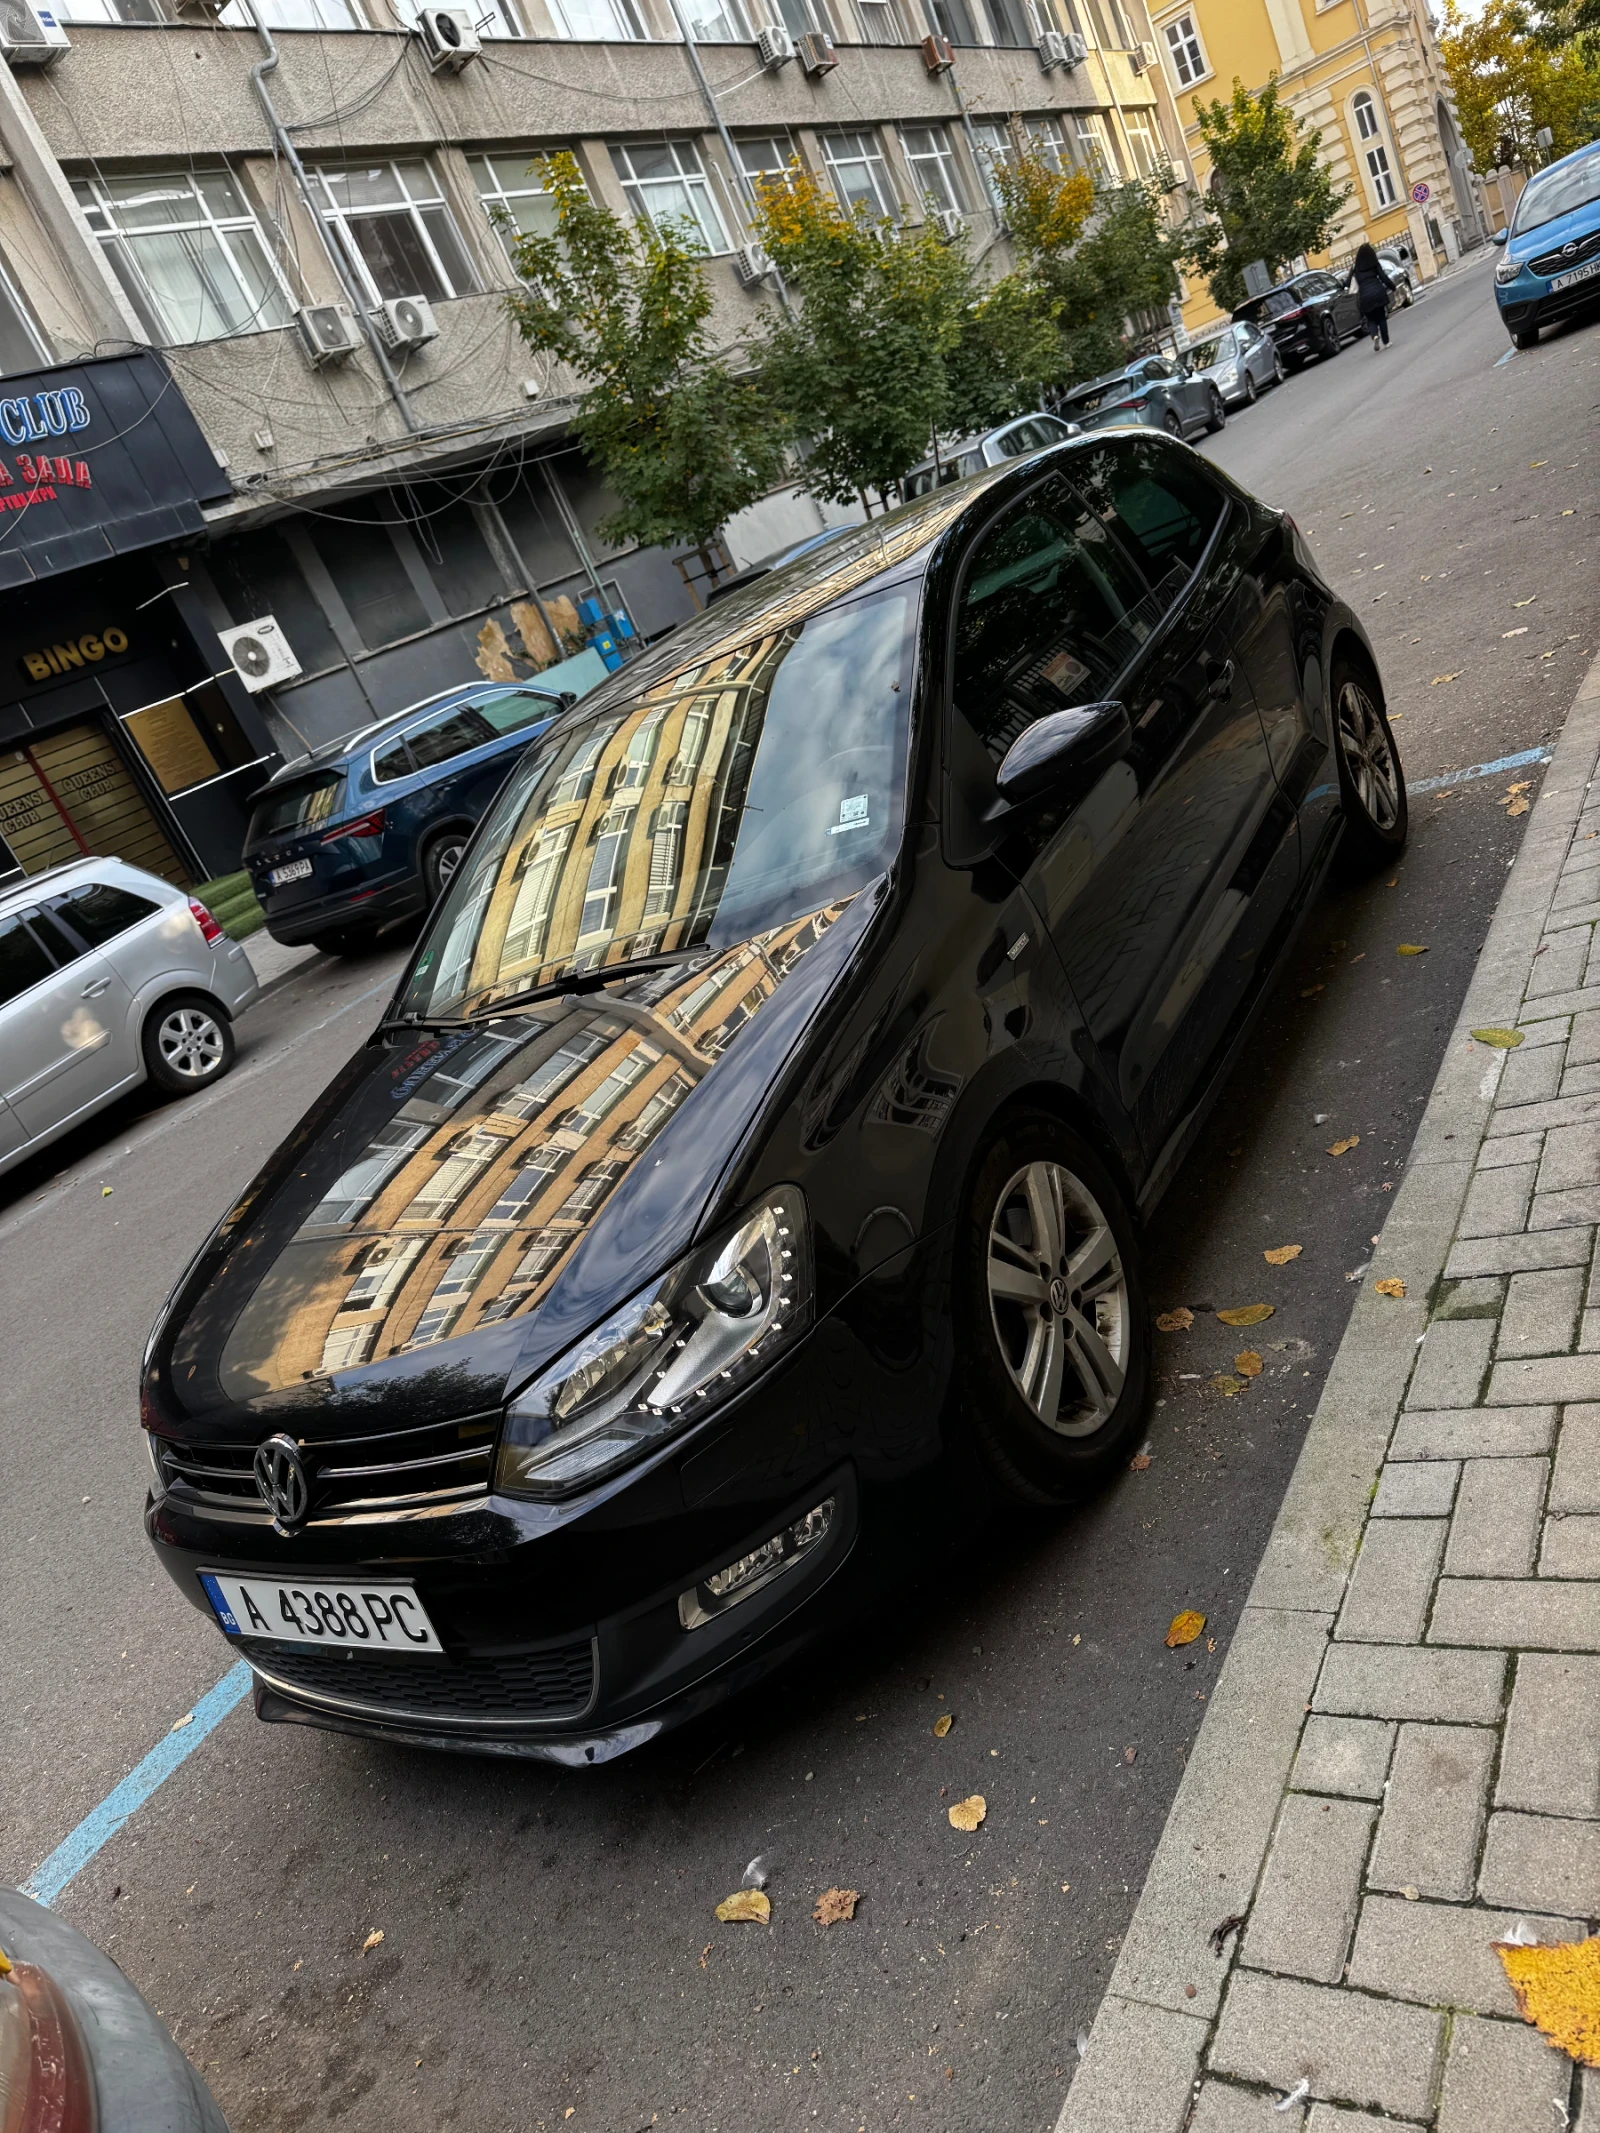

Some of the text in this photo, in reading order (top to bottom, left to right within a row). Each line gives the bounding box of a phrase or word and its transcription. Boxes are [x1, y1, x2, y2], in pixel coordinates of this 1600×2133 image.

[1557, 279, 1564, 289] A
[0, 387, 90, 446] CLUB
[23, 627, 128, 681] BINGO
[62, 763, 115, 792] QUEENS
[0, 791, 43, 822] UEENS
[219, 1611, 237, 1626] BG
[239, 1585, 428, 1643] A 4388PC
